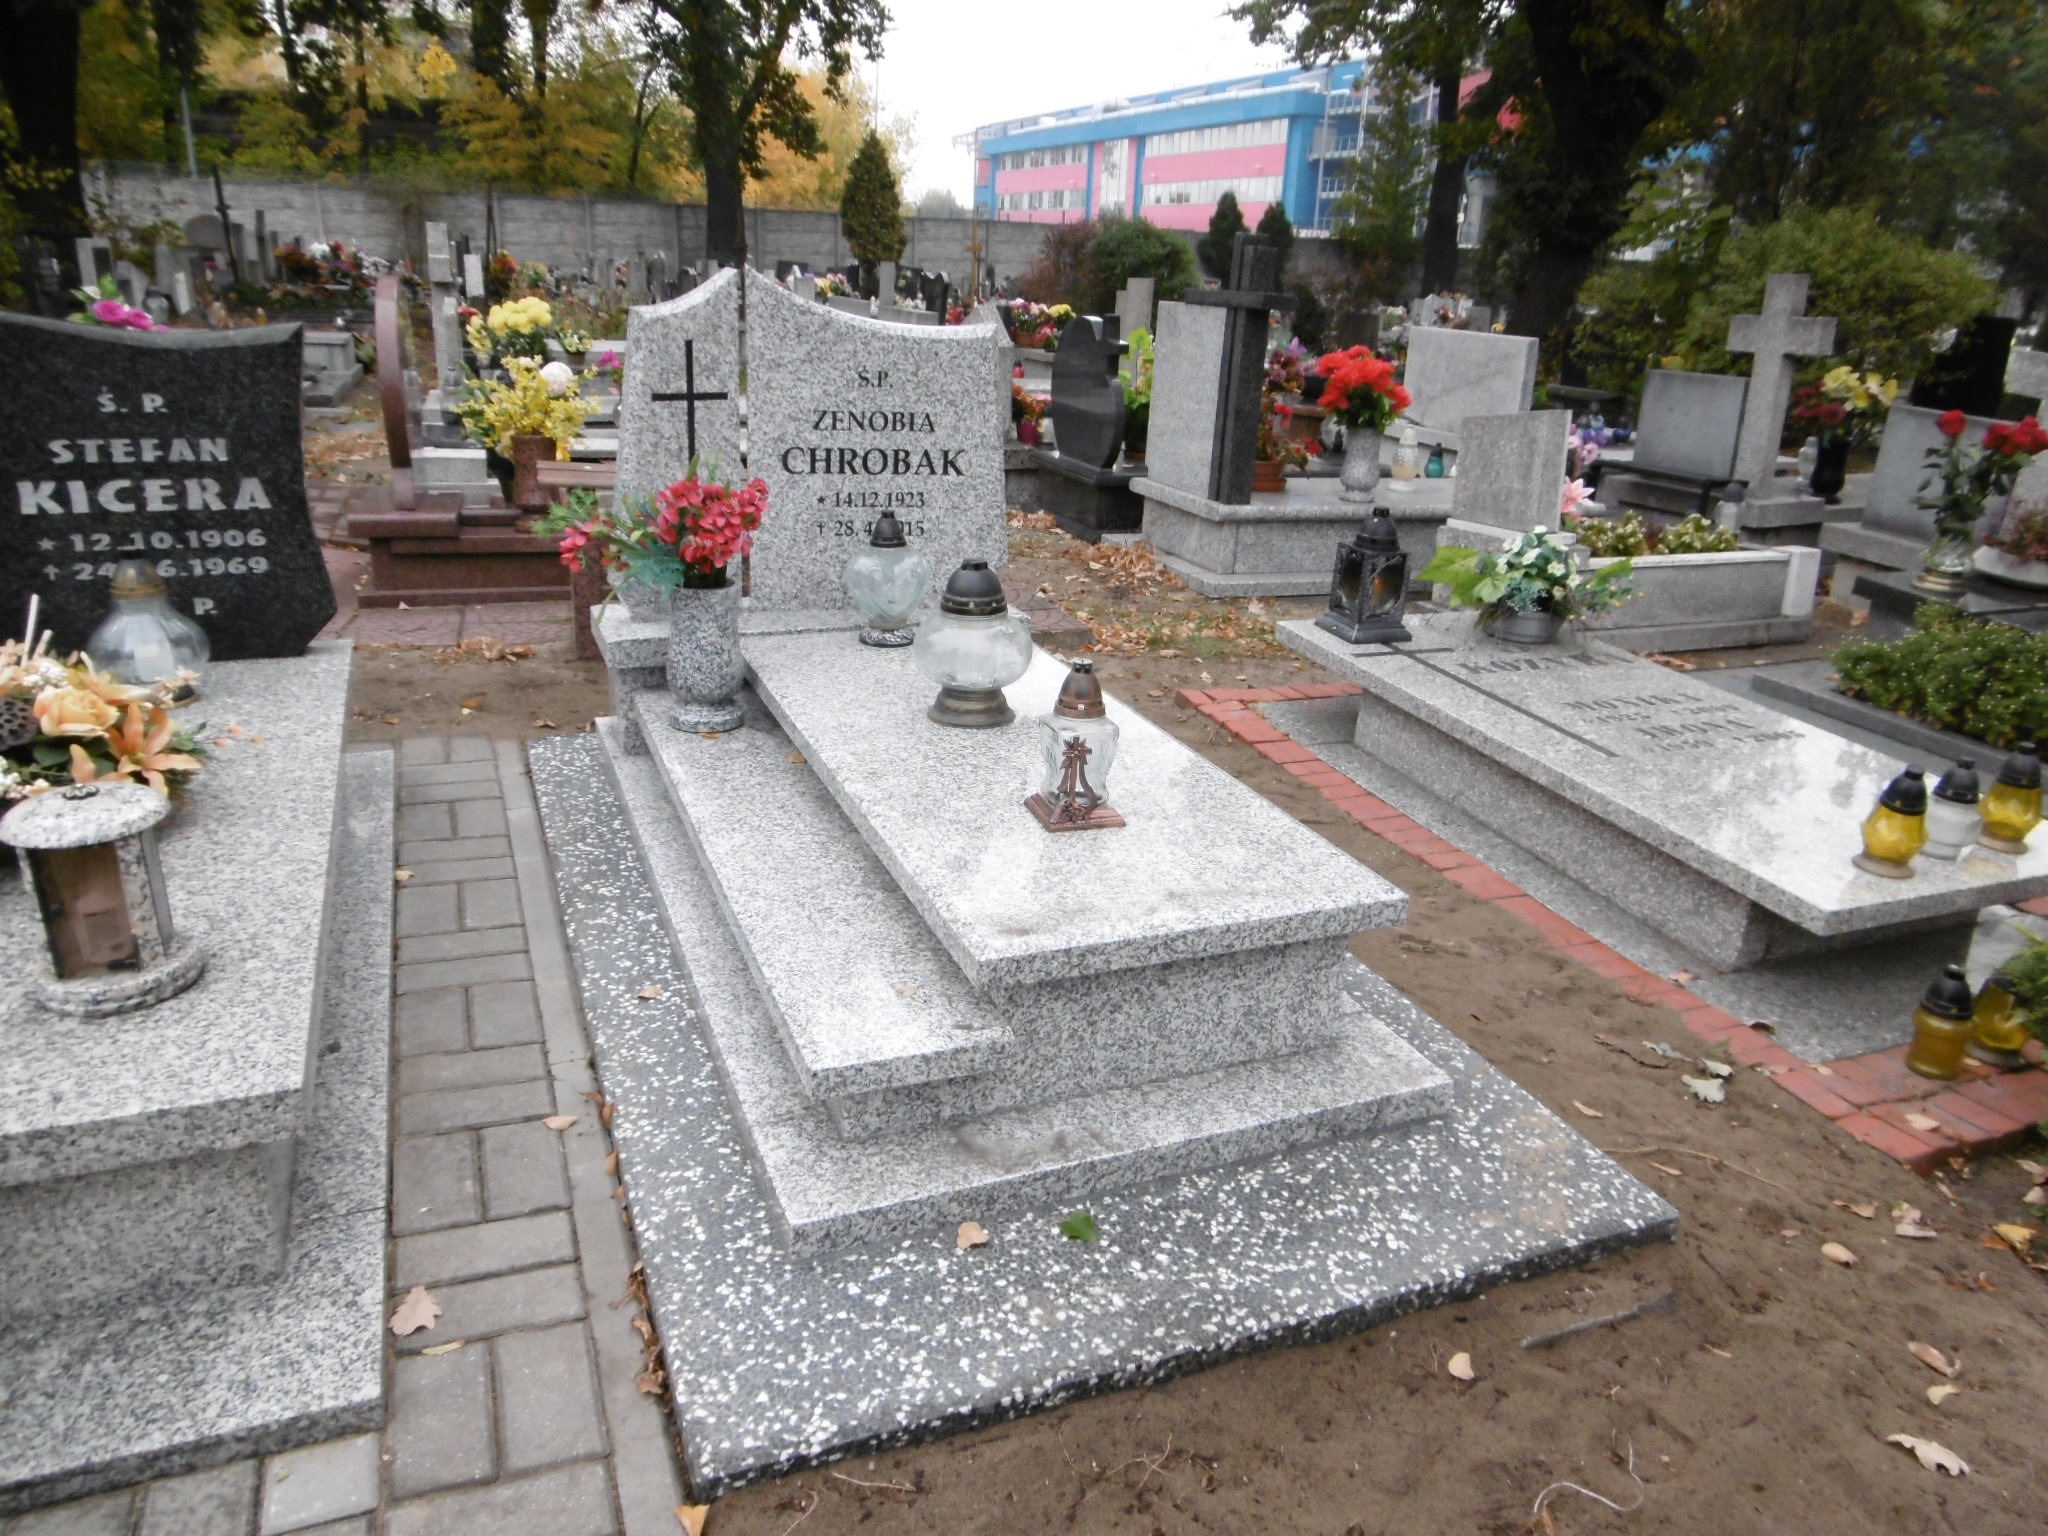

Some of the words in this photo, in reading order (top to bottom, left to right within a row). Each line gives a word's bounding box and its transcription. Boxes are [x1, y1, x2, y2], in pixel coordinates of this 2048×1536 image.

[812, 410, 935, 432] ZENOBIA
[49, 438, 228, 463] STEFAN
[781, 446, 964, 476] CHROBAK
[16, 477, 272, 515] KICERA
[834, 492, 925, 508] 14.12.1923
[835, 520, 859, 537] 28.
